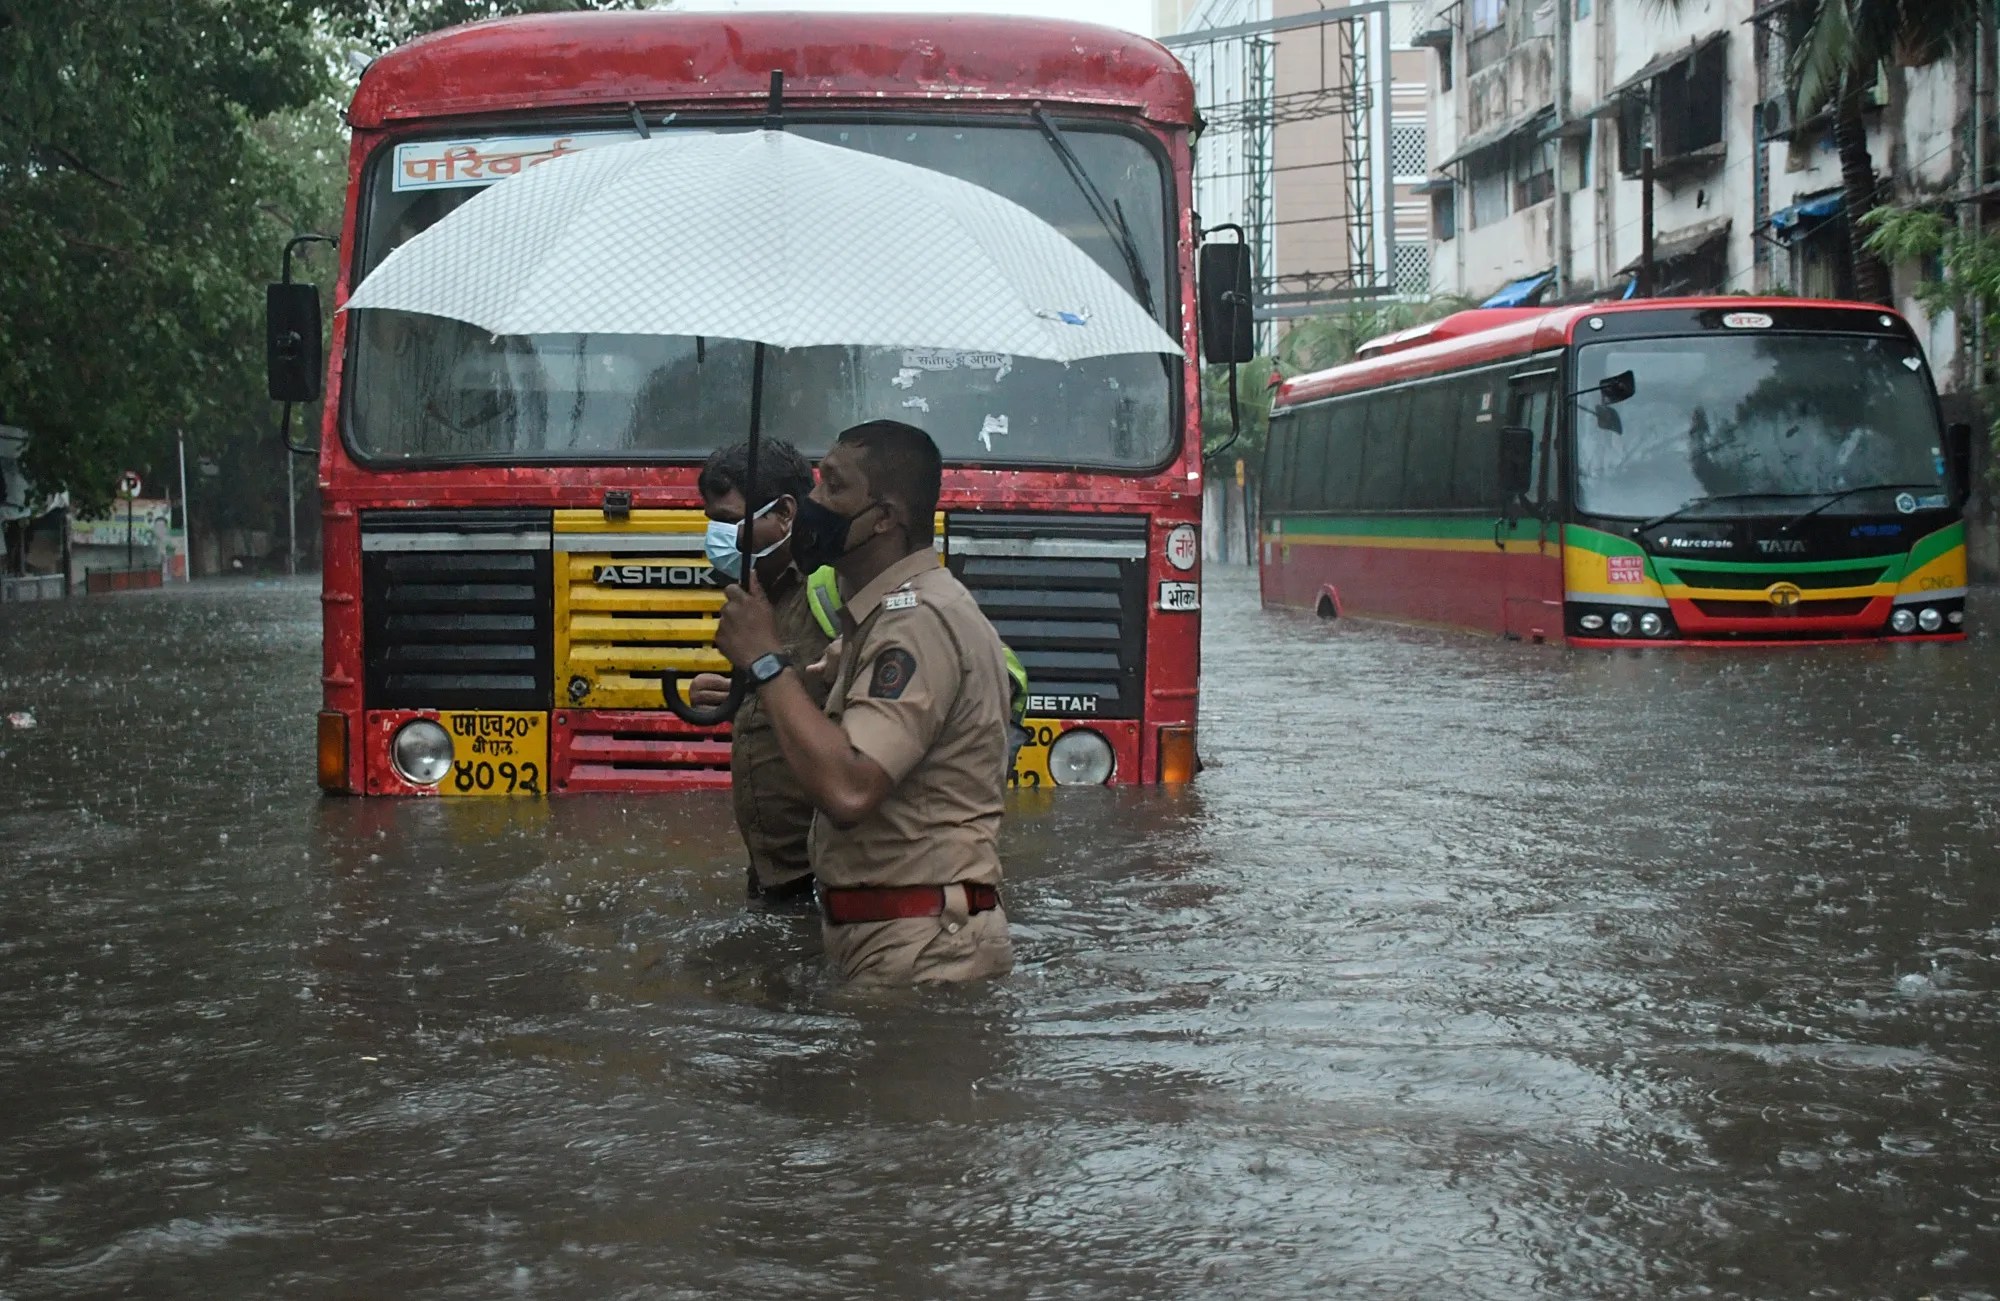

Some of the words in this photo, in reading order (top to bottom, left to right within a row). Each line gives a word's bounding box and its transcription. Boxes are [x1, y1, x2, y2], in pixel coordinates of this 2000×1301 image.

[1757, 540, 1806, 553] TATA
[598, 566, 717, 585] ASHOK
[1026, 695, 1097, 712] EETAH
